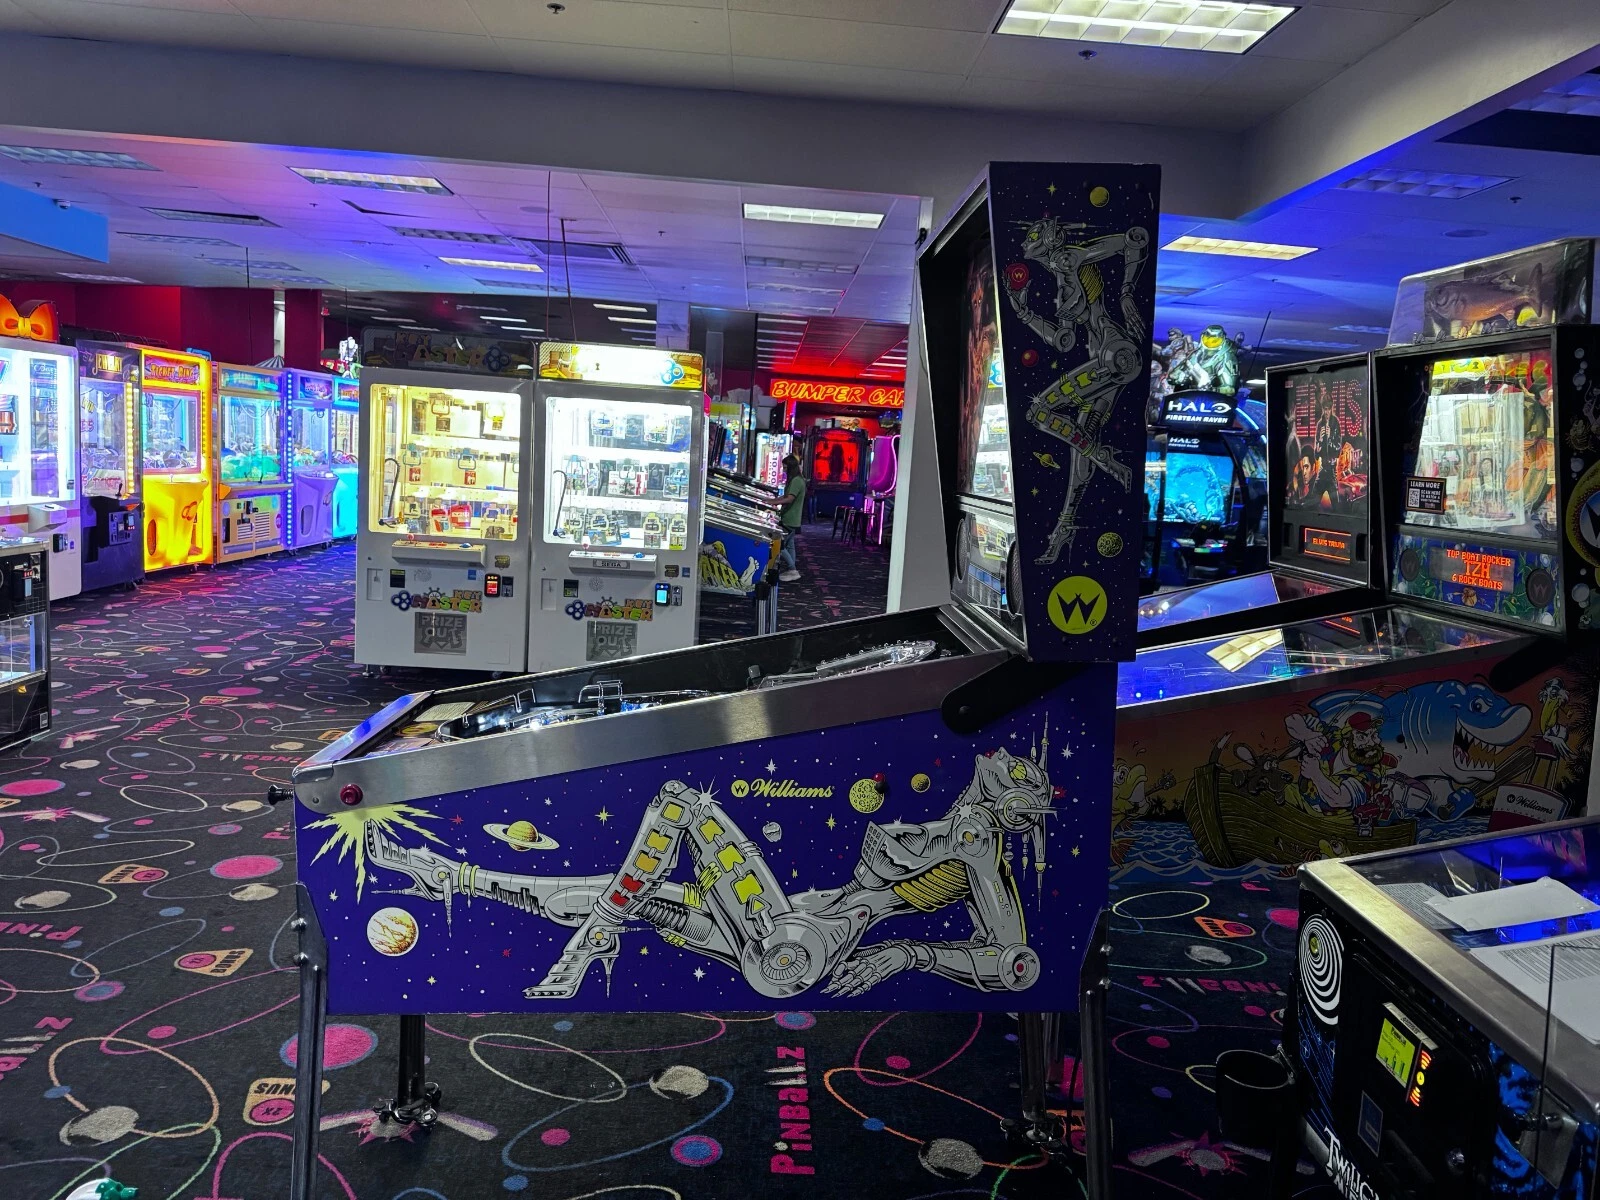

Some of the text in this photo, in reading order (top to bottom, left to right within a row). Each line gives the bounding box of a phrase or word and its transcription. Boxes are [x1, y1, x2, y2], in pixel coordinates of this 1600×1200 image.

[771, 381, 865, 403] BUMPER
[1167, 400, 1232, 413] HALO
[1295, 379, 1362, 437] ELVIS
[1169, 437, 1200, 445] HALO
[1312, 537, 1327, 547] ELVIS
[1446, 549, 1511, 567] TOP BOAT ROCKER
[1451, 573, 1503, 591] 6 ROCK BOATS
[453, 589, 482, 600] KEY
[411, 593, 482, 613] MASTER
[624, 598, 653, 608] KEY
[584, 602, 653, 621] MASTER
[421, 615, 464, 628] PRIZE
[596, 623, 633, 636] PRIZE
[750, 778, 833, 798] Williams
[1515, 795, 1554, 814] Williams
[253, 1082, 296, 1096] NUS
[261, 1106, 283, 1116] 2X
